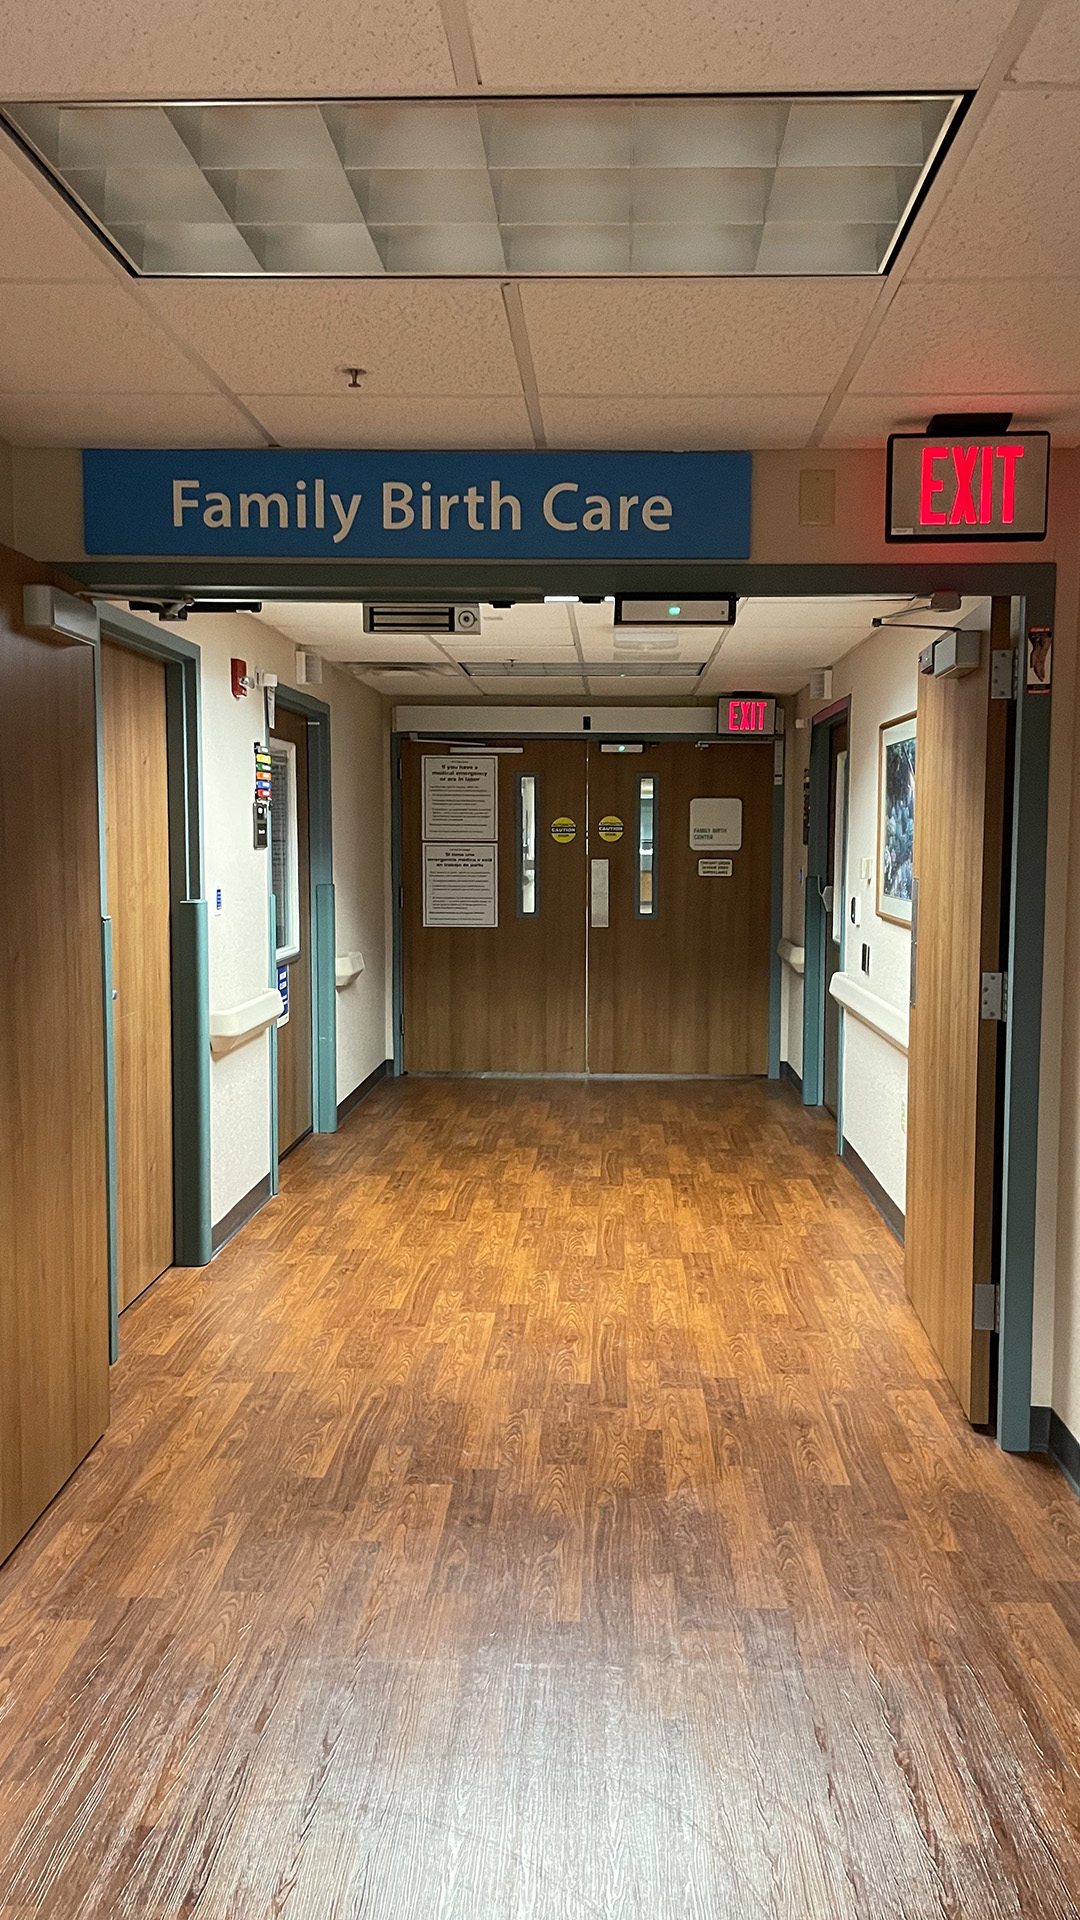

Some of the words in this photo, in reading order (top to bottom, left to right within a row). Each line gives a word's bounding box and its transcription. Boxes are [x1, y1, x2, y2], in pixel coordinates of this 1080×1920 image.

[172, 478, 362, 543] Family
[382, 481, 521, 530] Birth
[543, 482, 673, 531] Care
[919, 446, 1024, 525] EXIT
[728, 701, 767, 731] EXIT
